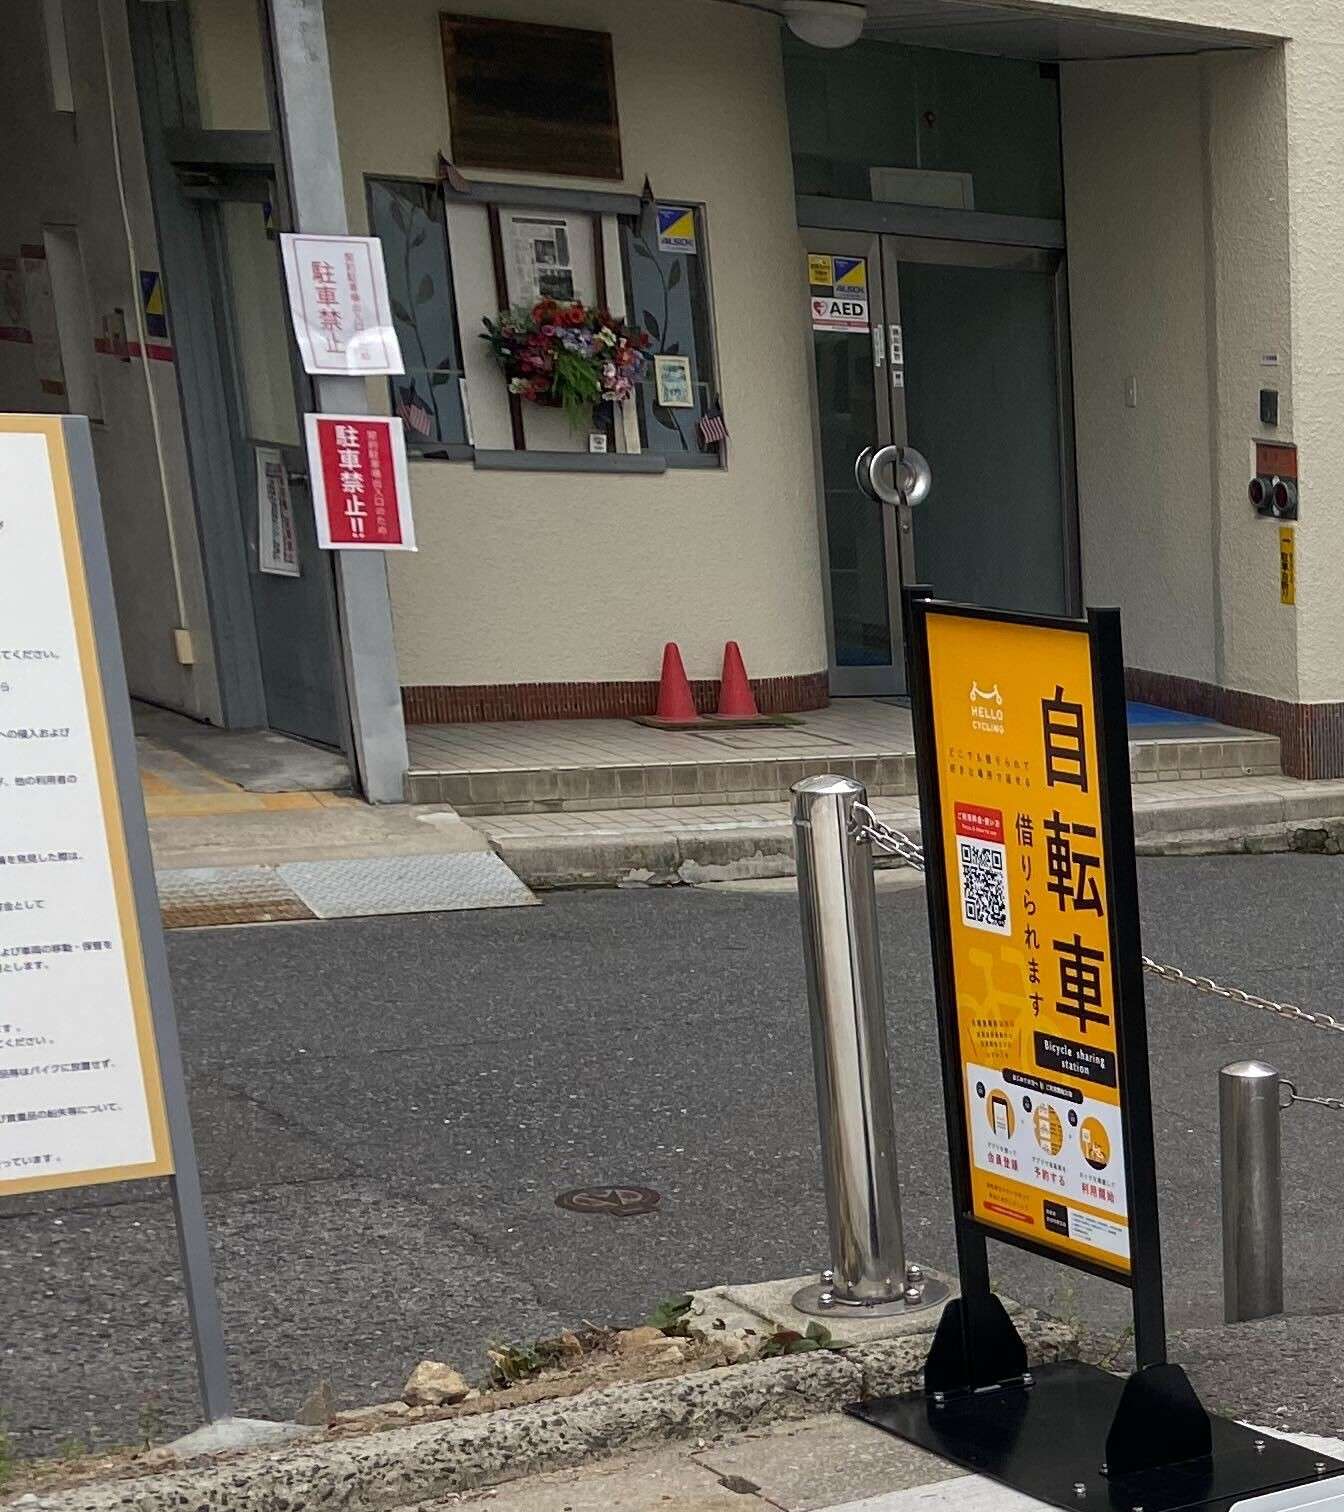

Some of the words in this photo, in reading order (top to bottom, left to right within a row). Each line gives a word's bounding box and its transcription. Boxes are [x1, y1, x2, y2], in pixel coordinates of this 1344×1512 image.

[829, 302, 864, 317] AED
[0, 649, 60, 660] てください。
[971, 705, 1004, 721] HELLO
[972, 720, 1005, 735] CYCLING
[1040, 684, 1111, 1034] 自転車
[1015, 812, 1044, 1017] 借りられます
[0, 961, 49, 973] とします。
[1043, 1039, 1073, 1057] Bicycle
[1076, 1047, 1106, 1070] sharing
[1061, 1059, 1090, 1075] station
[0, 1154, 61, 1168] っています。
[1033, 1167, 1066, 1187] 予約する
